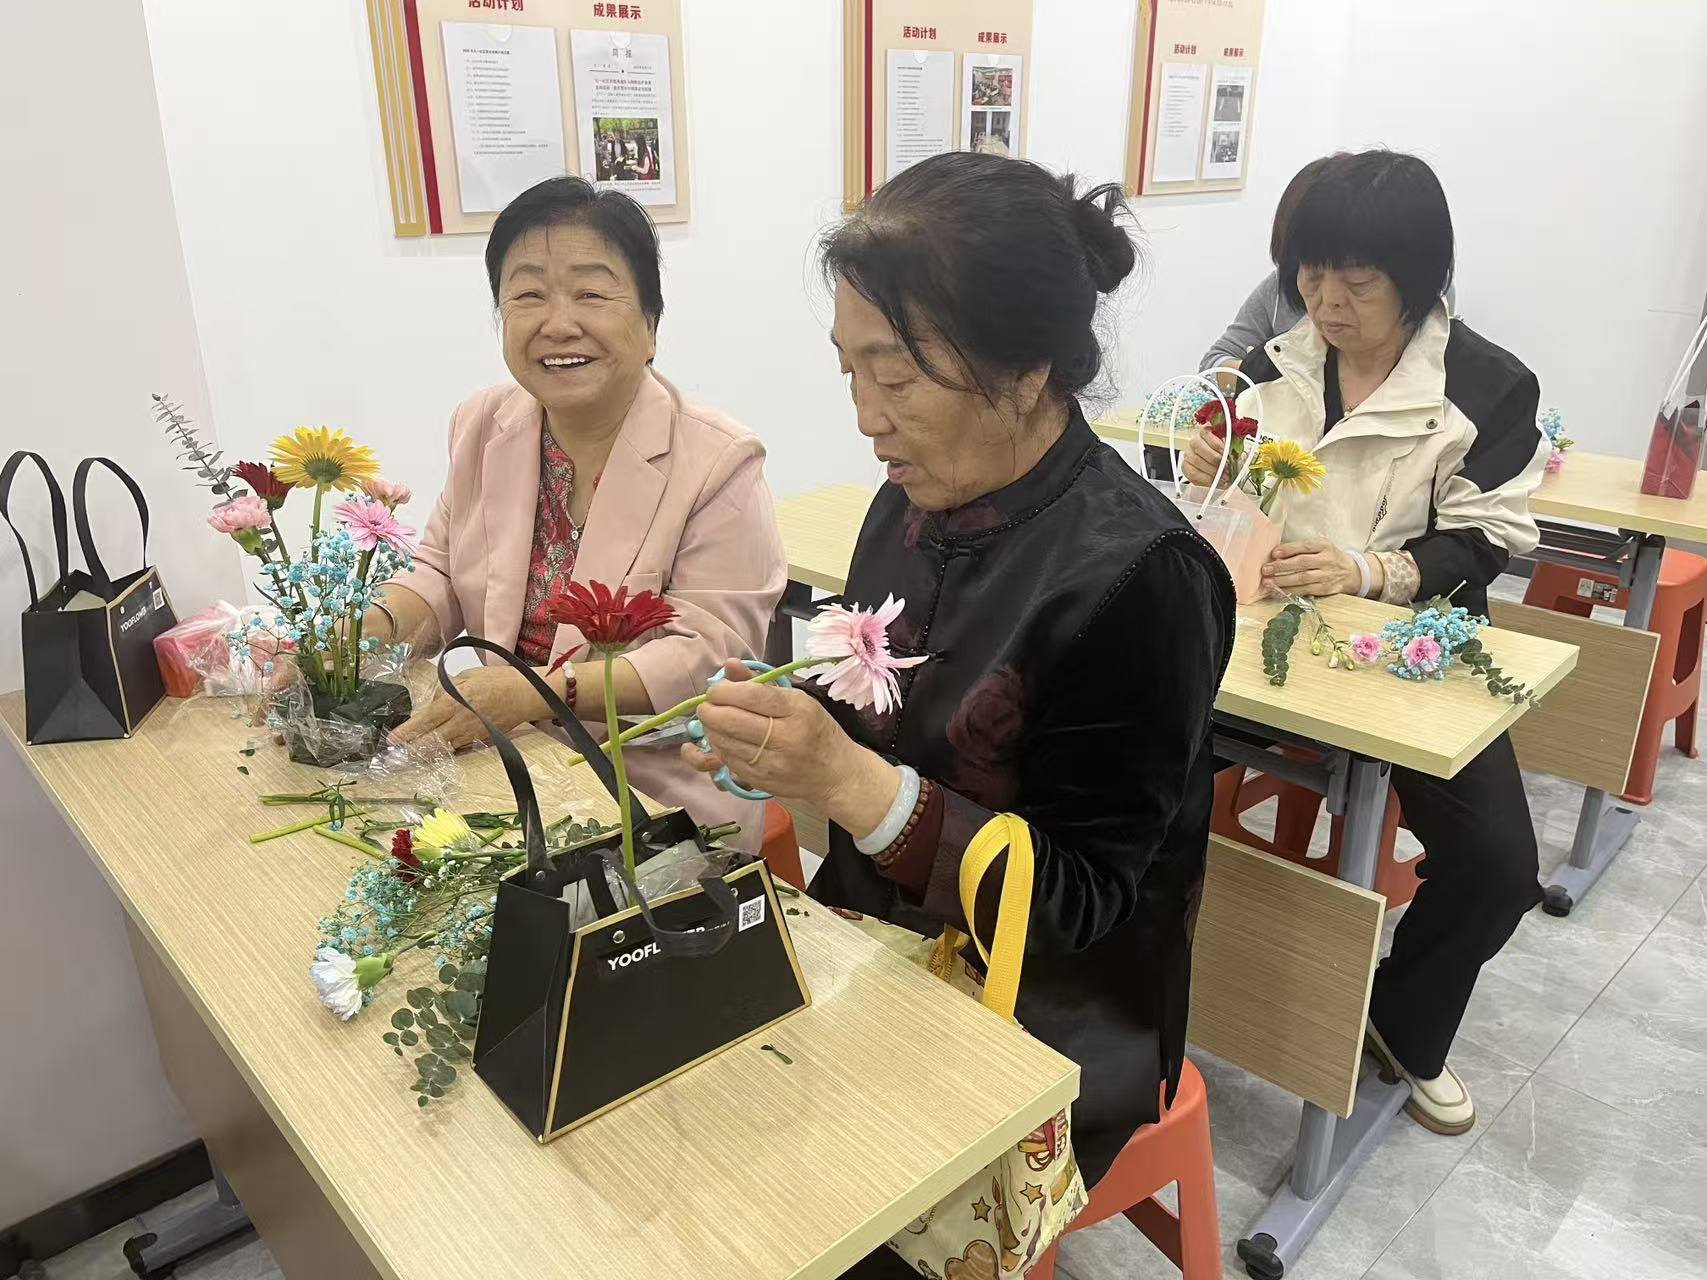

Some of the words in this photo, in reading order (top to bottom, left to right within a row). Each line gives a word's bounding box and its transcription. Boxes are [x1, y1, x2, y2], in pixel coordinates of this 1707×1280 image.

[593, 3, 642, 20] 成果展示
[903, 25, 937, 40] 活动计划
[977, 31, 1008, 45] 成果展示
